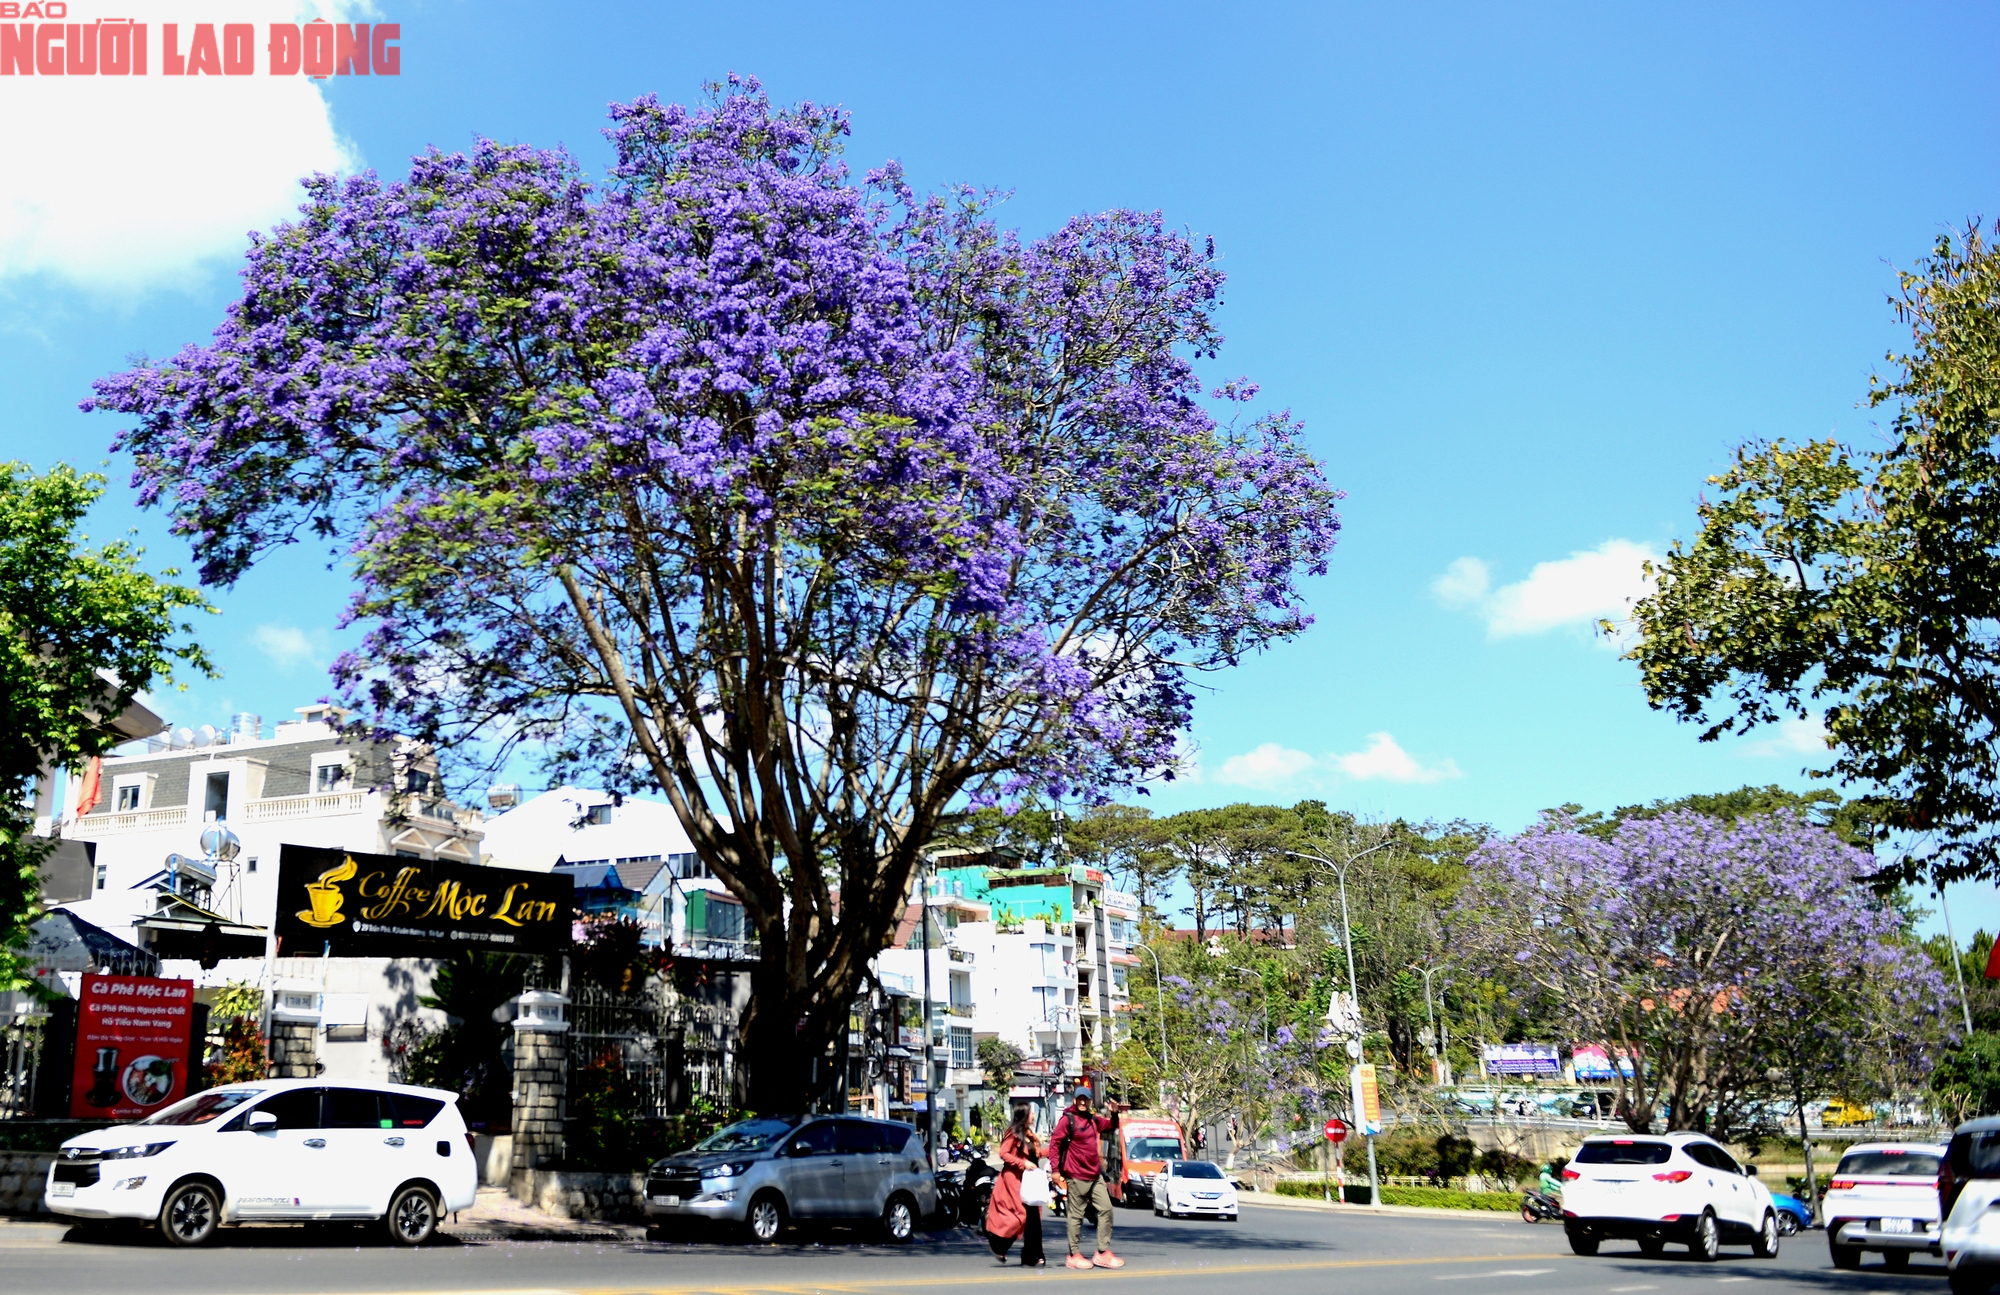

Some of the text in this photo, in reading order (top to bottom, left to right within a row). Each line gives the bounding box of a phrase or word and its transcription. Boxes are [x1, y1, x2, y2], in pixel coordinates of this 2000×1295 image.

[359, 866, 556, 927] Coffee Mộc Lan
[91, 981, 187, 999] Cà Phê Mộc Lan
[89, 1003, 186, 1015] Cà Phê Phin Nguyên Chất
[114, 1017, 131, 1026] Tiếu
[133, 1018, 150, 1027] Nam
[152, 1019, 172, 1029] Vang
